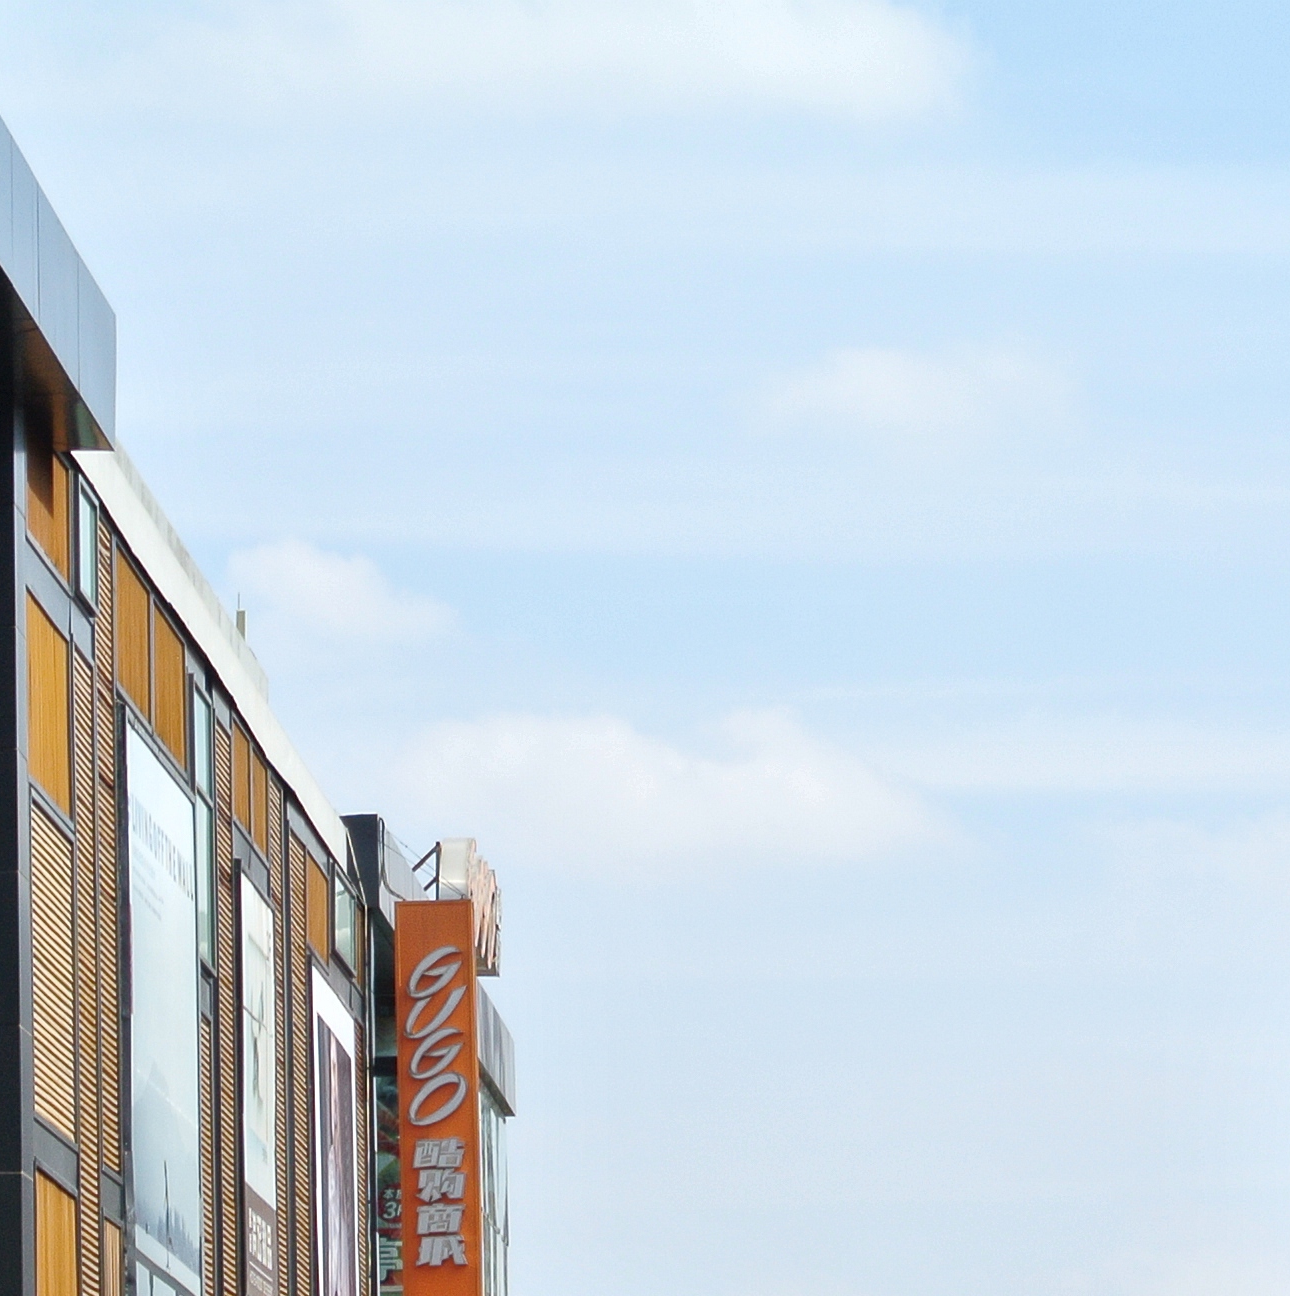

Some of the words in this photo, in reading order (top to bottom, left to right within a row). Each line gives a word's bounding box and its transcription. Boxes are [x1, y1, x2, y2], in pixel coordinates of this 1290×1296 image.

[383, 1188, 401, 1199] 本
[413, 1137, 468, 1267] 酷购商城
